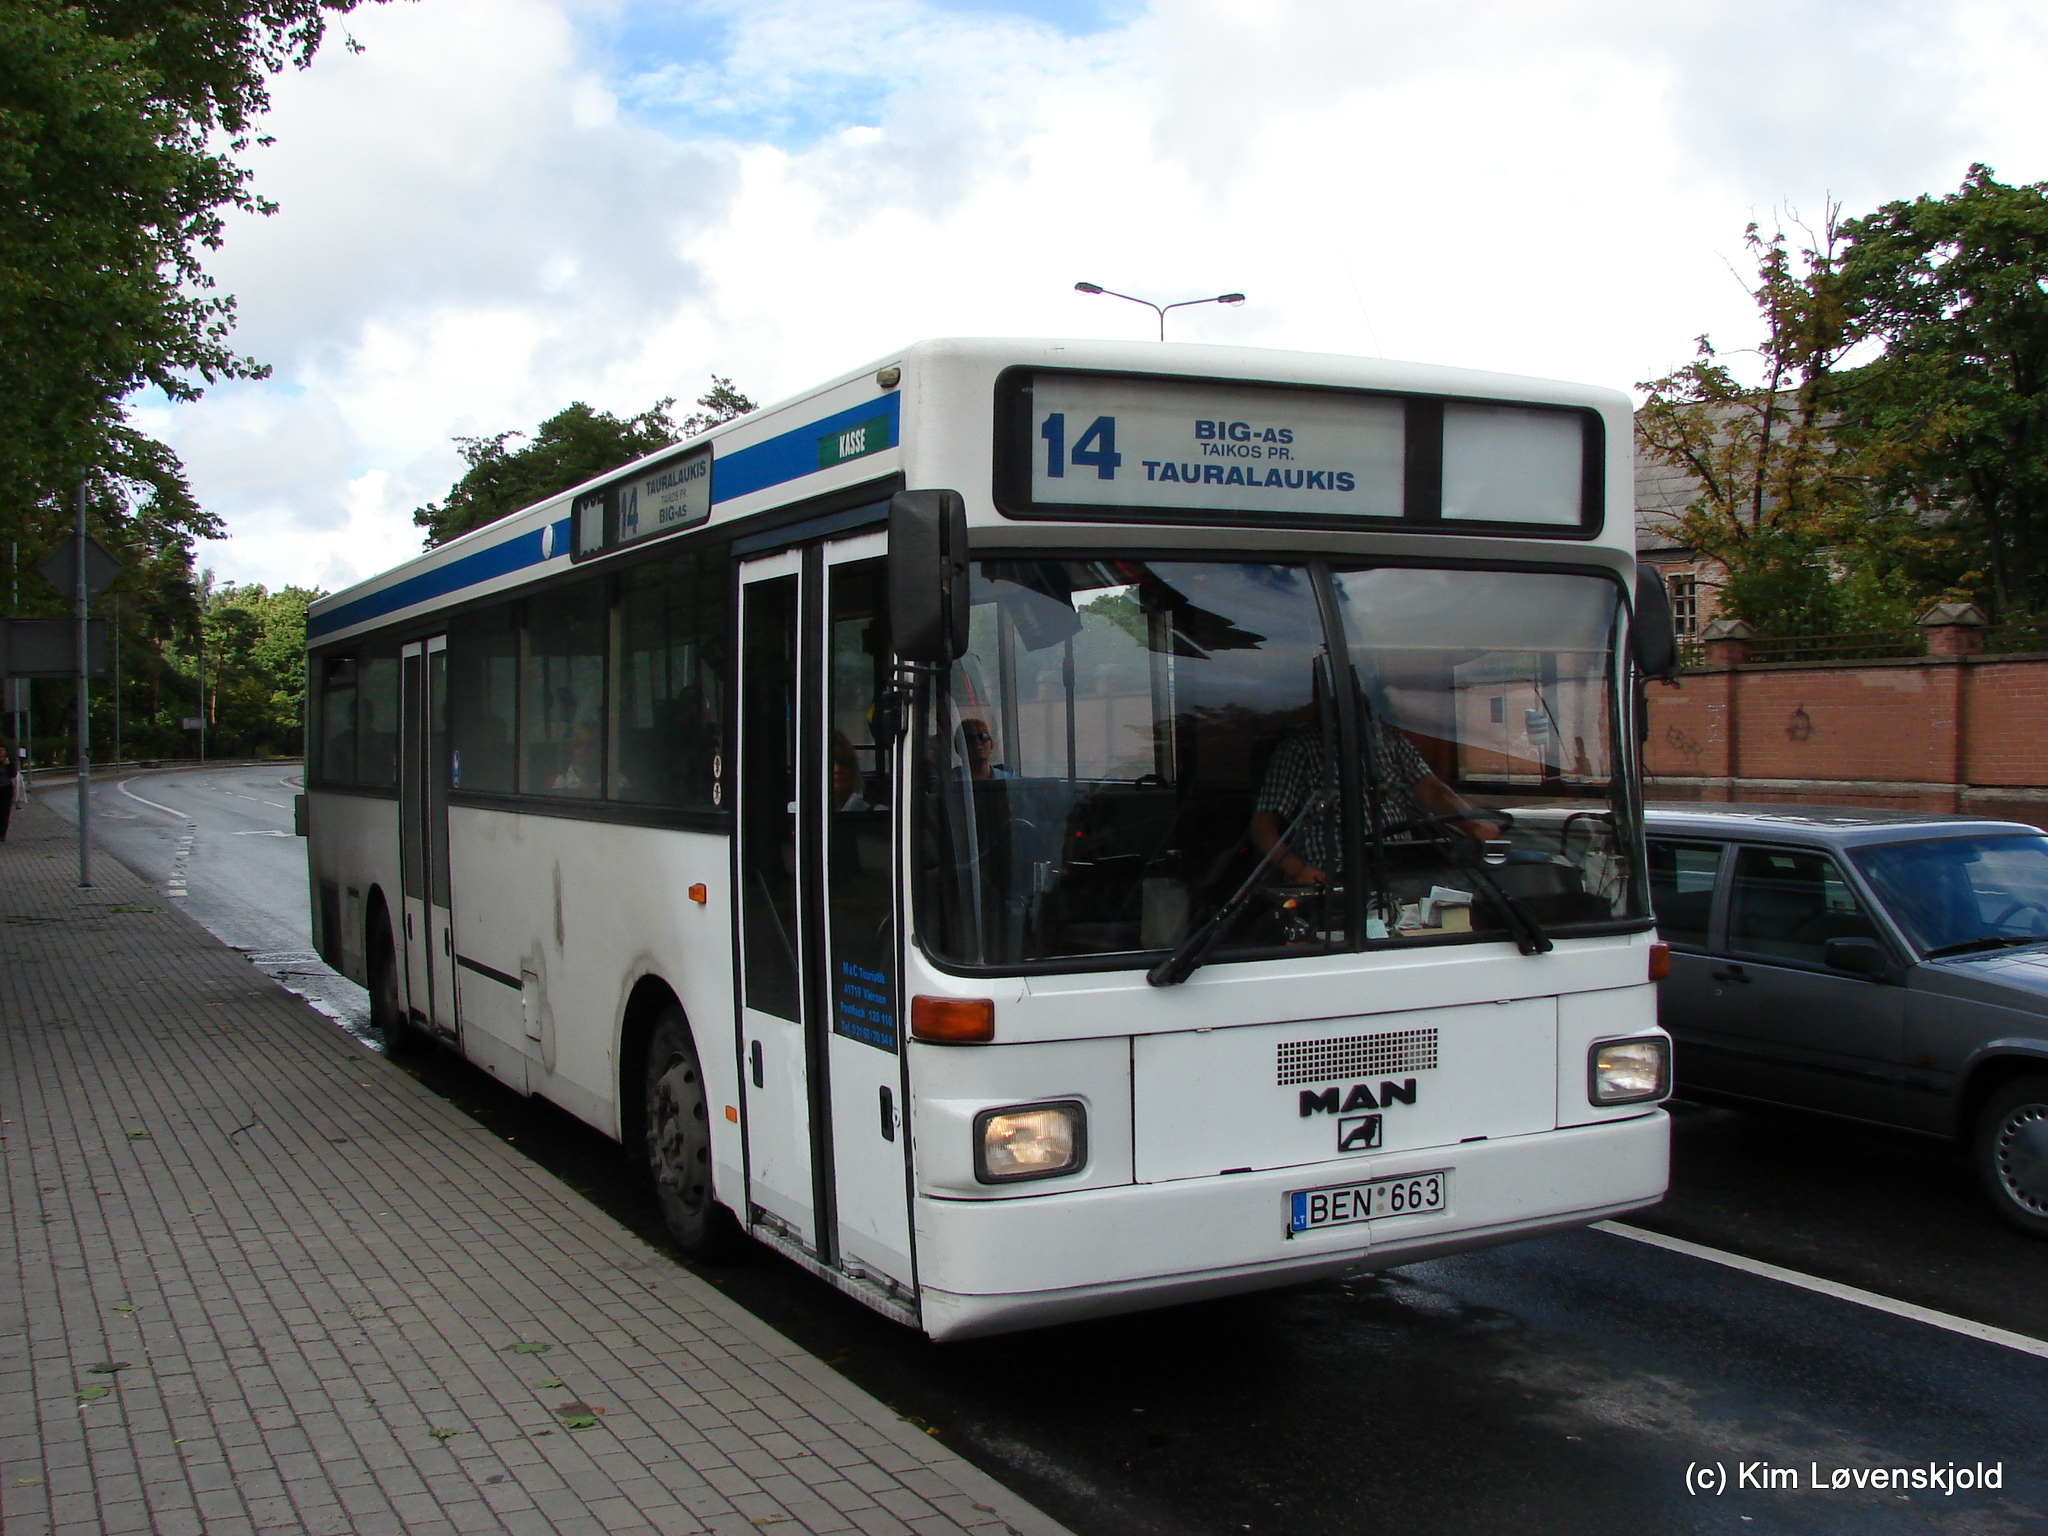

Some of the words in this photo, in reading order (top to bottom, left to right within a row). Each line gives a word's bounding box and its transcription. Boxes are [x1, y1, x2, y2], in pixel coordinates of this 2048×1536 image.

[839, 428, 866, 459] KASSE
[1041, 412, 1122, 481] 14
[1194, 419, 1294, 446] BIG-AS
[1200, 442, 1263, 460] TAIKOS
[1267, 445, 1295, 462] PR.
[646, 460, 706, 497] TAURALAUKIS
[1142, 460, 1355, 493] TAURALAUKIS
[621, 486, 638, 539] 14
[659, 504, 687, 524] BIG-AS
[862, 988, 887, 1005] Viersen
[1299, 1078, 1417, 1117] MAN
[1310, 1188, 1372, 1224] BEN
[1390, 1177, 1441, 1212] 663
[1293, 1215, 1306, 1226] LT
